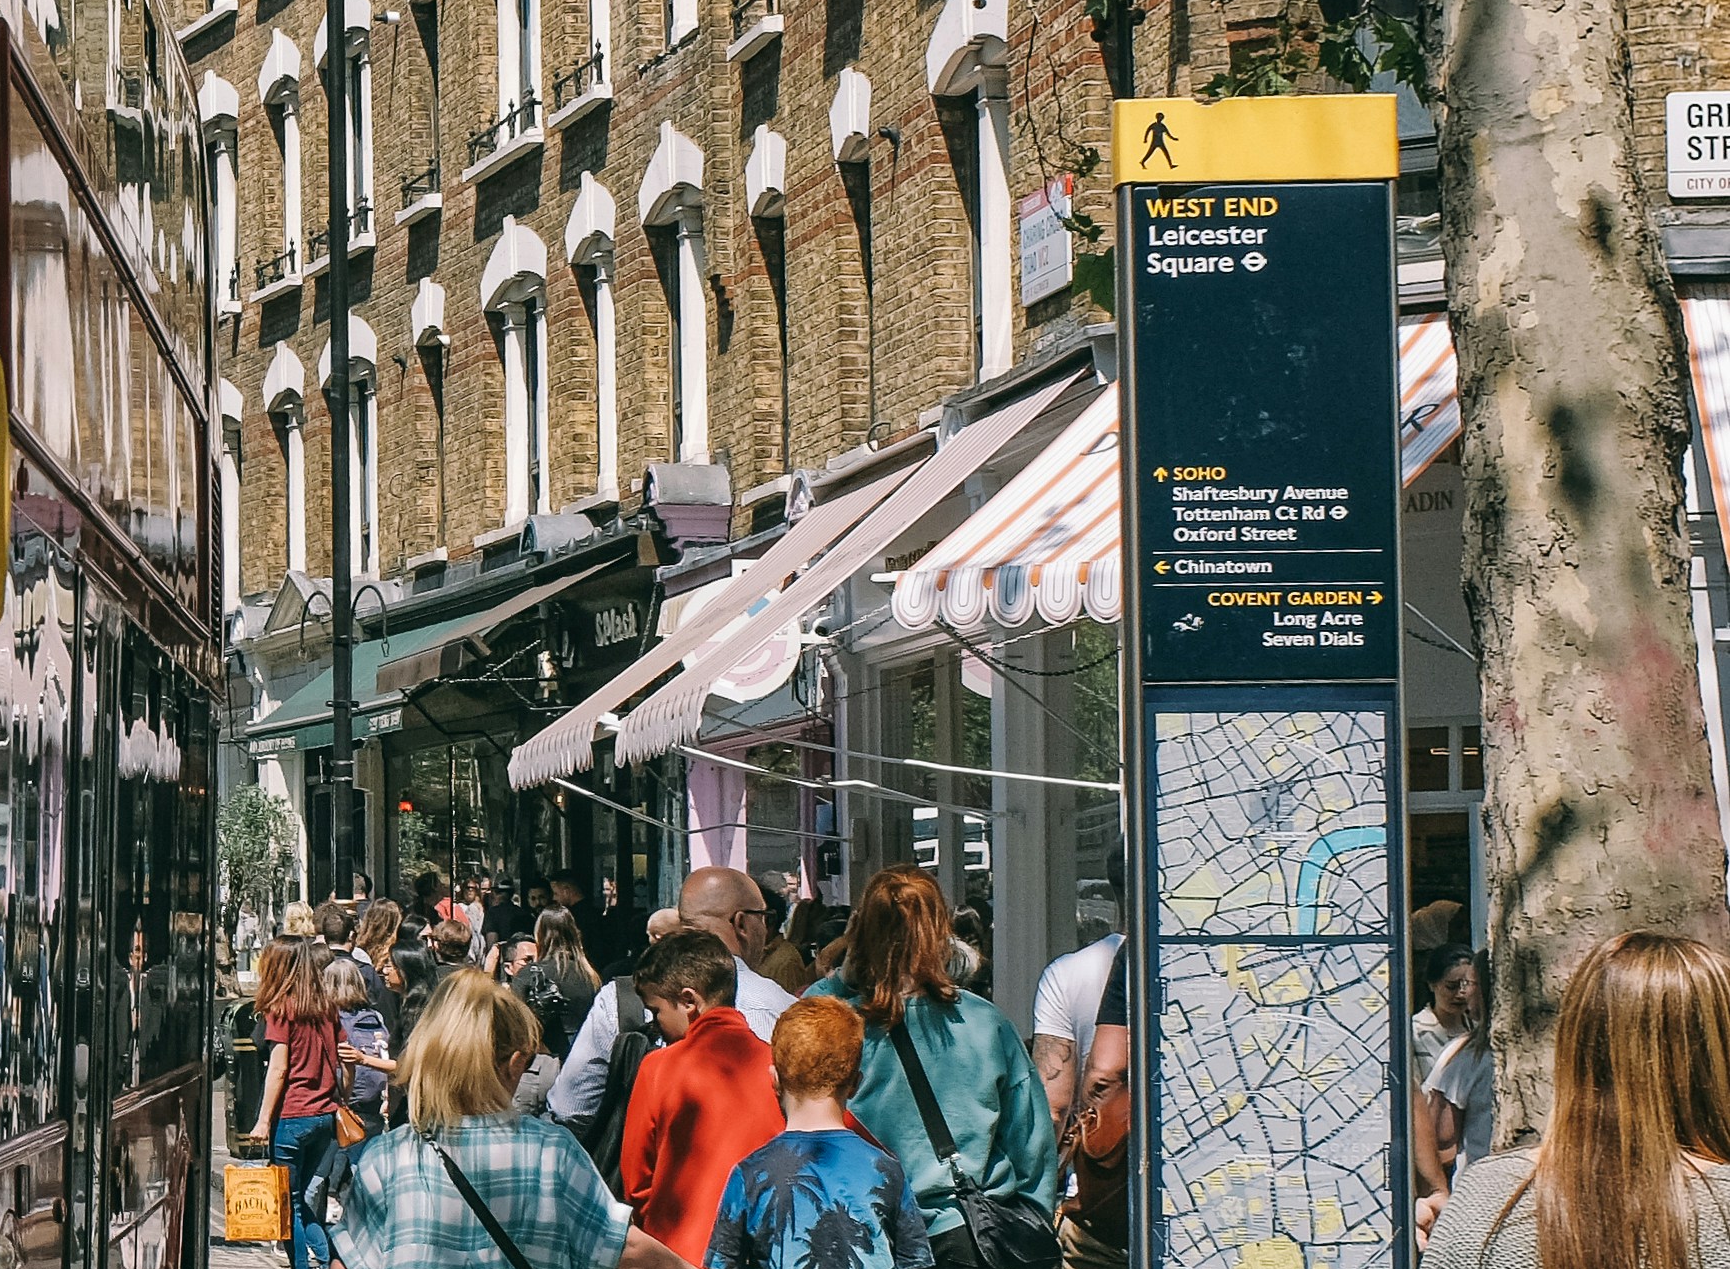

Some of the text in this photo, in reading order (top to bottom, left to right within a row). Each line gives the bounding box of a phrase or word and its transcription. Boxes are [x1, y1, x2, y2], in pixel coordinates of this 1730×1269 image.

[1687, 103, 1730, 129] GR
[1687, 178, 1714, 190] CITY
[1146, 197, 1279, 218] WEST END
[1148, 225, 1268, 246] Leicester
[1147, 252, 1234, 278] Square
[1172, 467, 1226, 481] SOHO
[1172, 486, 1349, 503] Shaftesbury Avenue
[1172, 506, 1325, 521] Tottenham Ct Rd
[1172, 527, 1297, 542] Oxford Street
[1174, 560, 1273, 574] Chinatown
[1207, 591, 1363, 606] COVENT GARDEN
[1273, 611, 1363, 629] Long Acre
[1262, 631, 1364, 647] Seven Dials
